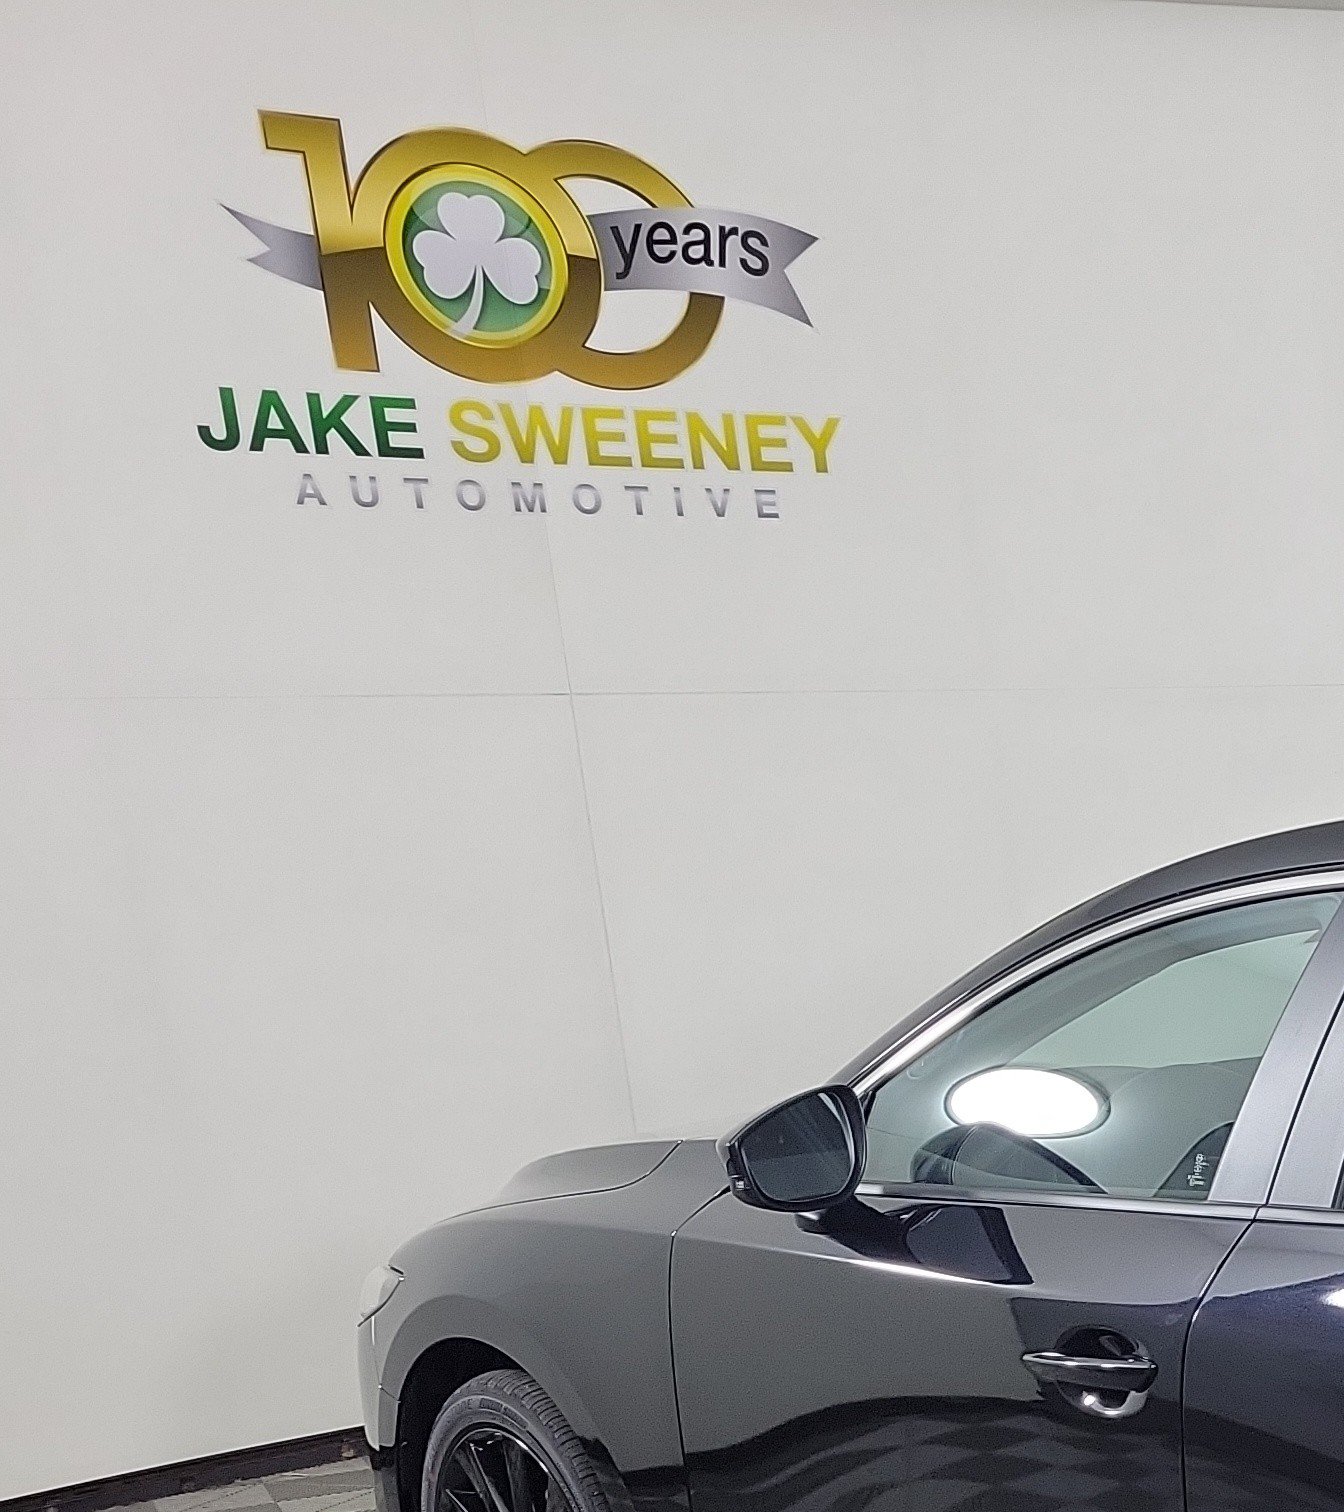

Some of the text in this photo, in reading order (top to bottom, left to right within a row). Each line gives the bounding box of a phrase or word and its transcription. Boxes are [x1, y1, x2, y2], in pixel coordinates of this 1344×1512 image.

[257, 108, 725, 391] 100
[610, 219, 771, 281] years
[196, 386, 842, 474] JAKE SWEENEY
[295, 473, 781, 520] AUTOMOTIVE
